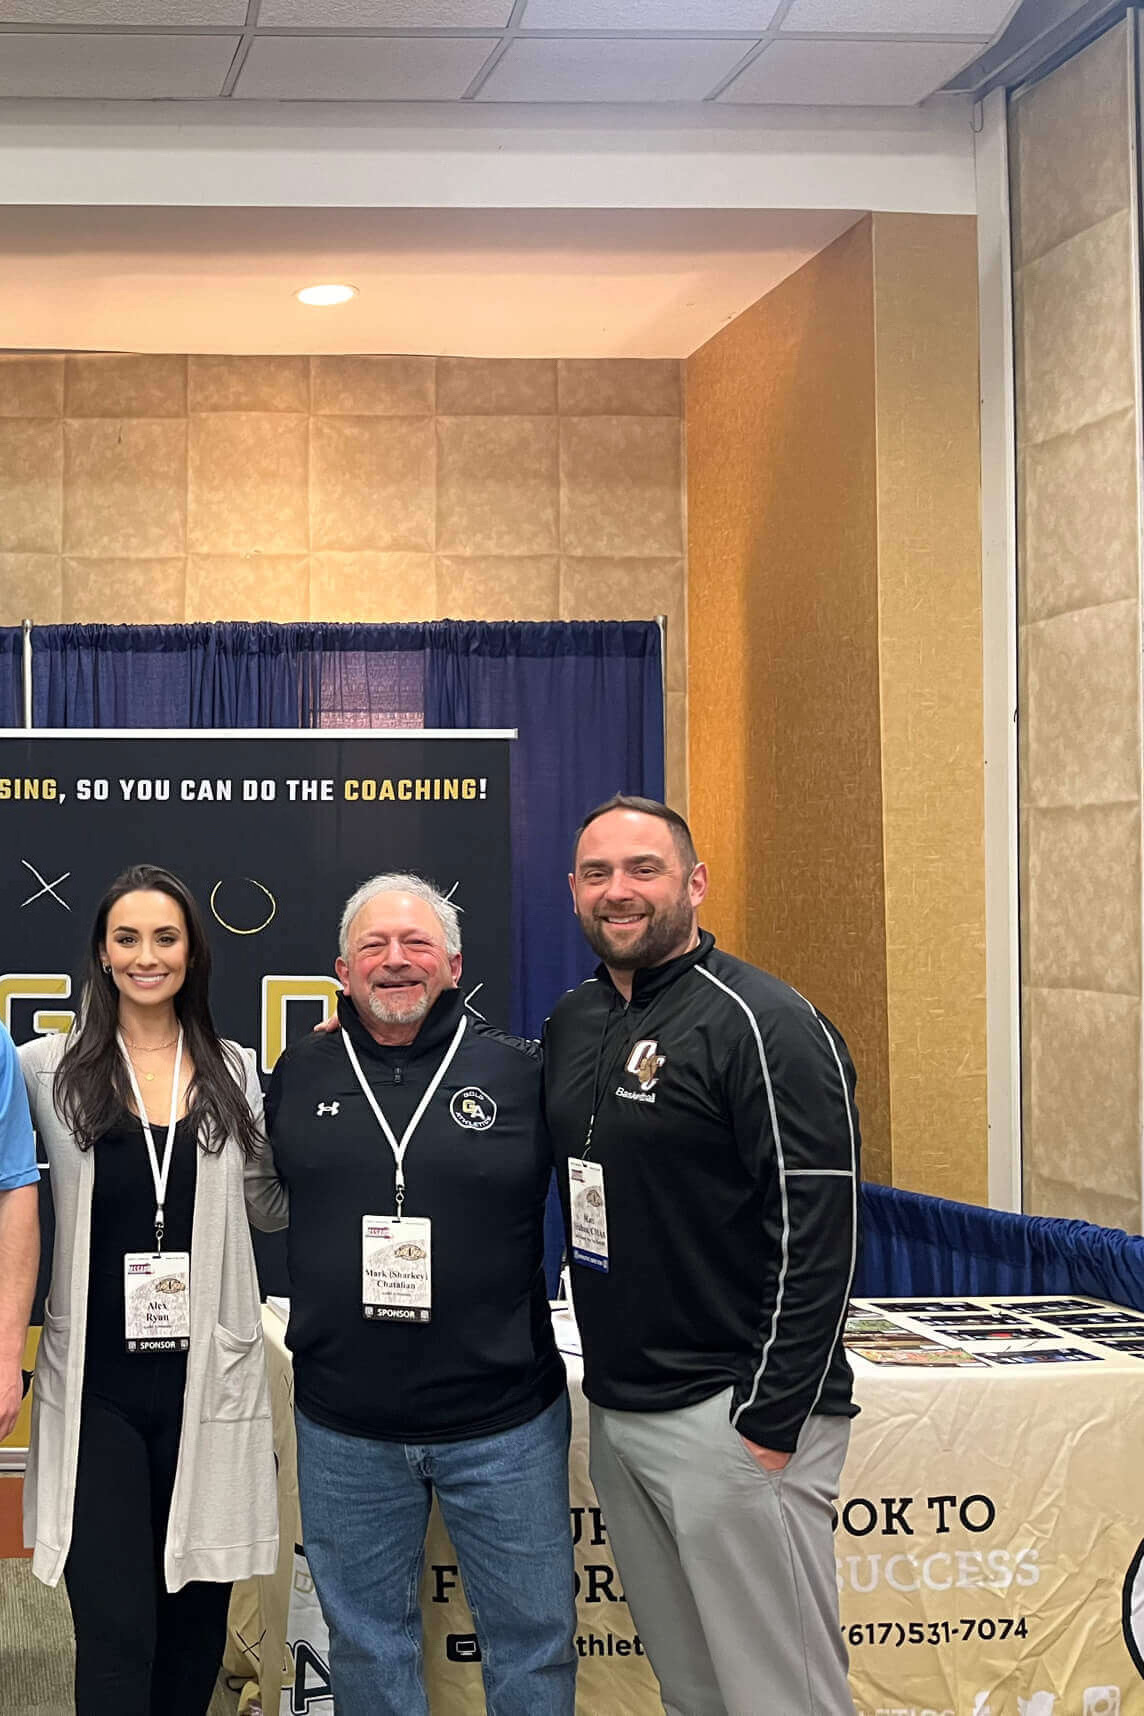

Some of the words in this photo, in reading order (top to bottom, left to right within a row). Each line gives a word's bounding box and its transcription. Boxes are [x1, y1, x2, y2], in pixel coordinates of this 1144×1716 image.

[76, 780, 109, 800] SO
[119, 780, 170, 801] YOU
[180, 780, 232, 801] CAN
[243, 780, 276, 801] DO
[286, 780, 334, 801] THE
[344, 779, 487, 801] COACHING!
[365, 1269, 389, 1279] Mark
[147, 1301, 168, 1311] Alex
[146, 1313, 169, 1324] Ryan
[377, 1308, 416, 1319] SPONSOR
[140, 1341, 176, 1351] SPONSOR
[927, 1494, 996, 1533] TO
